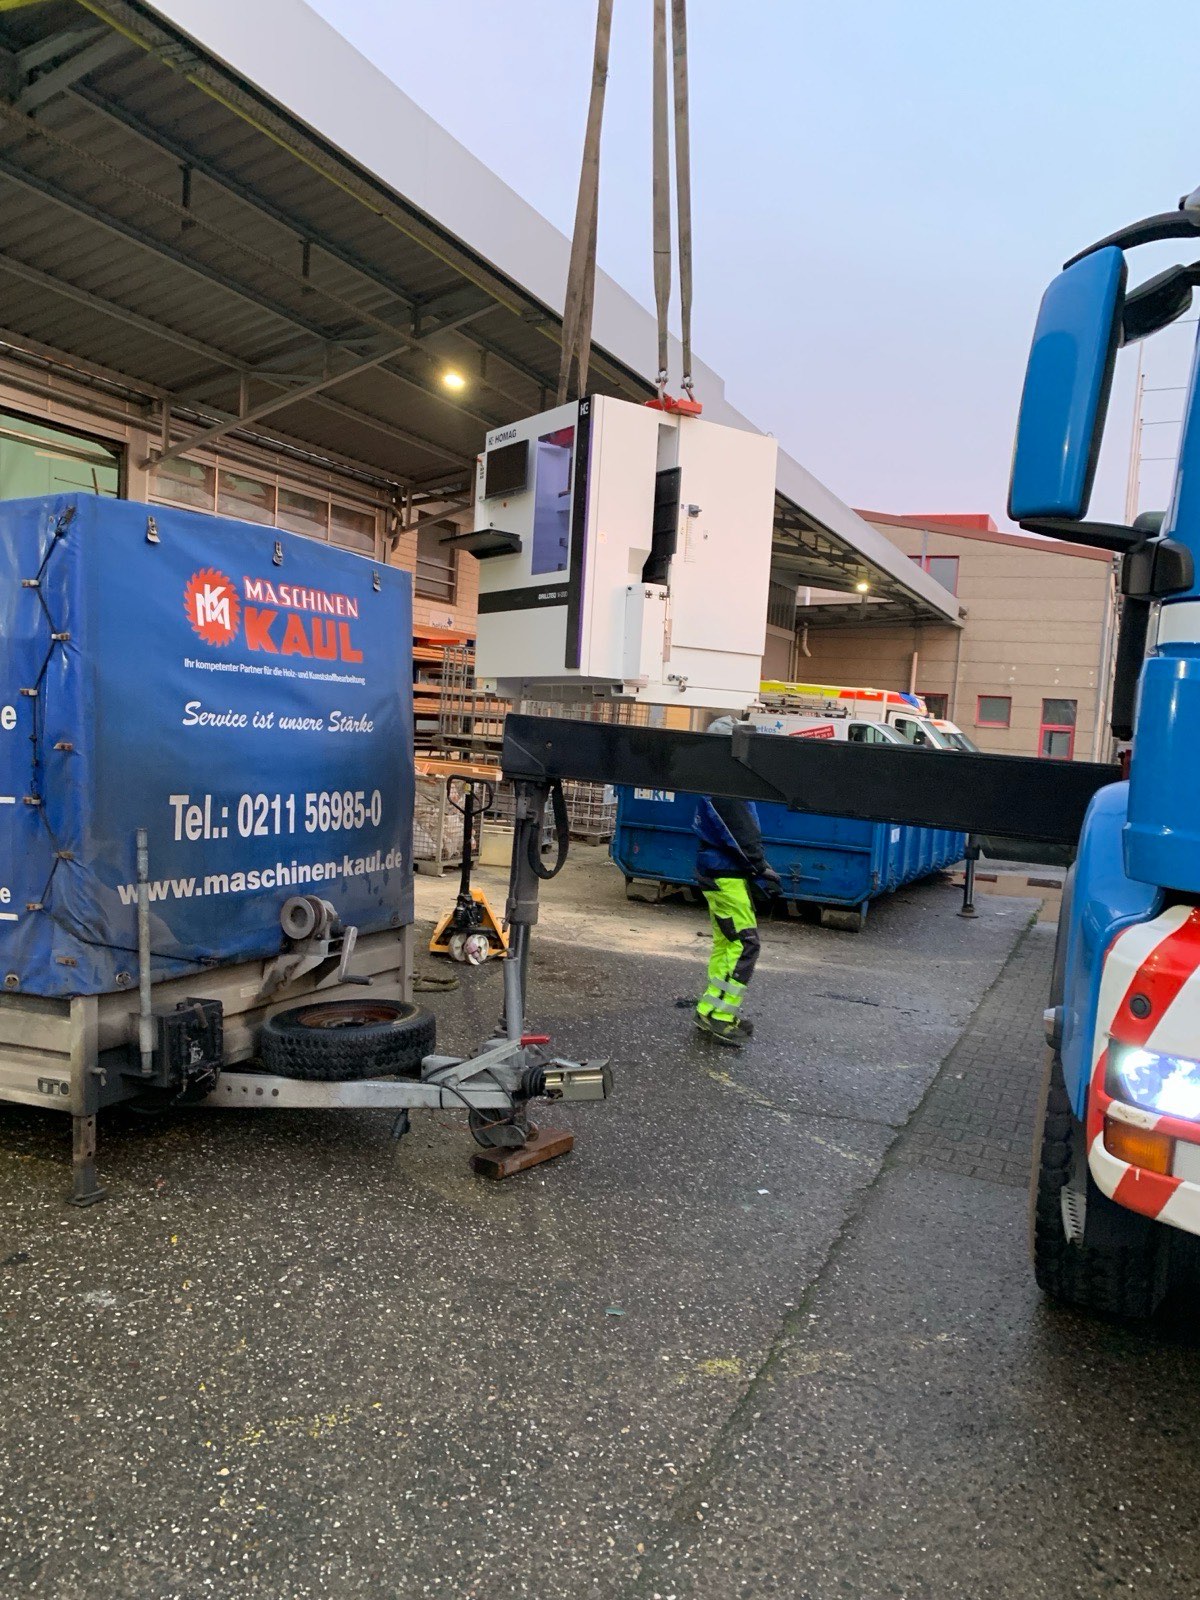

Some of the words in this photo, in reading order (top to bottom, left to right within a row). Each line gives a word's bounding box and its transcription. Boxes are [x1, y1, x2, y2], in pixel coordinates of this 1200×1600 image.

[495, 429, 517, 443] HOMAG
[244, 577, 359, 619] MASCHINEN
[244, 607, 363, 662] KAUL
[184, 658, 195, 668] Ihr
[195, 659, 239, 672] kompetenter
[240, 664, 263, 674] Partner
[264, 666, 272, 675] für
[273, 667, 282, 676] die
[298, 671, 308, 679] und
[183, 701, 248, 727] Service
[252, 711, 275, 729] ist
[278, 716, 323, 731] unsere
[328, 710, 374, 733] Stärke
[169, 795, 229, 841] Tel.:
[237, 793, 295, 838] 0211
[304, 789, 382, 833] 56985-0
[117, 847, 403, 905] www.maschinen-kaul.de
